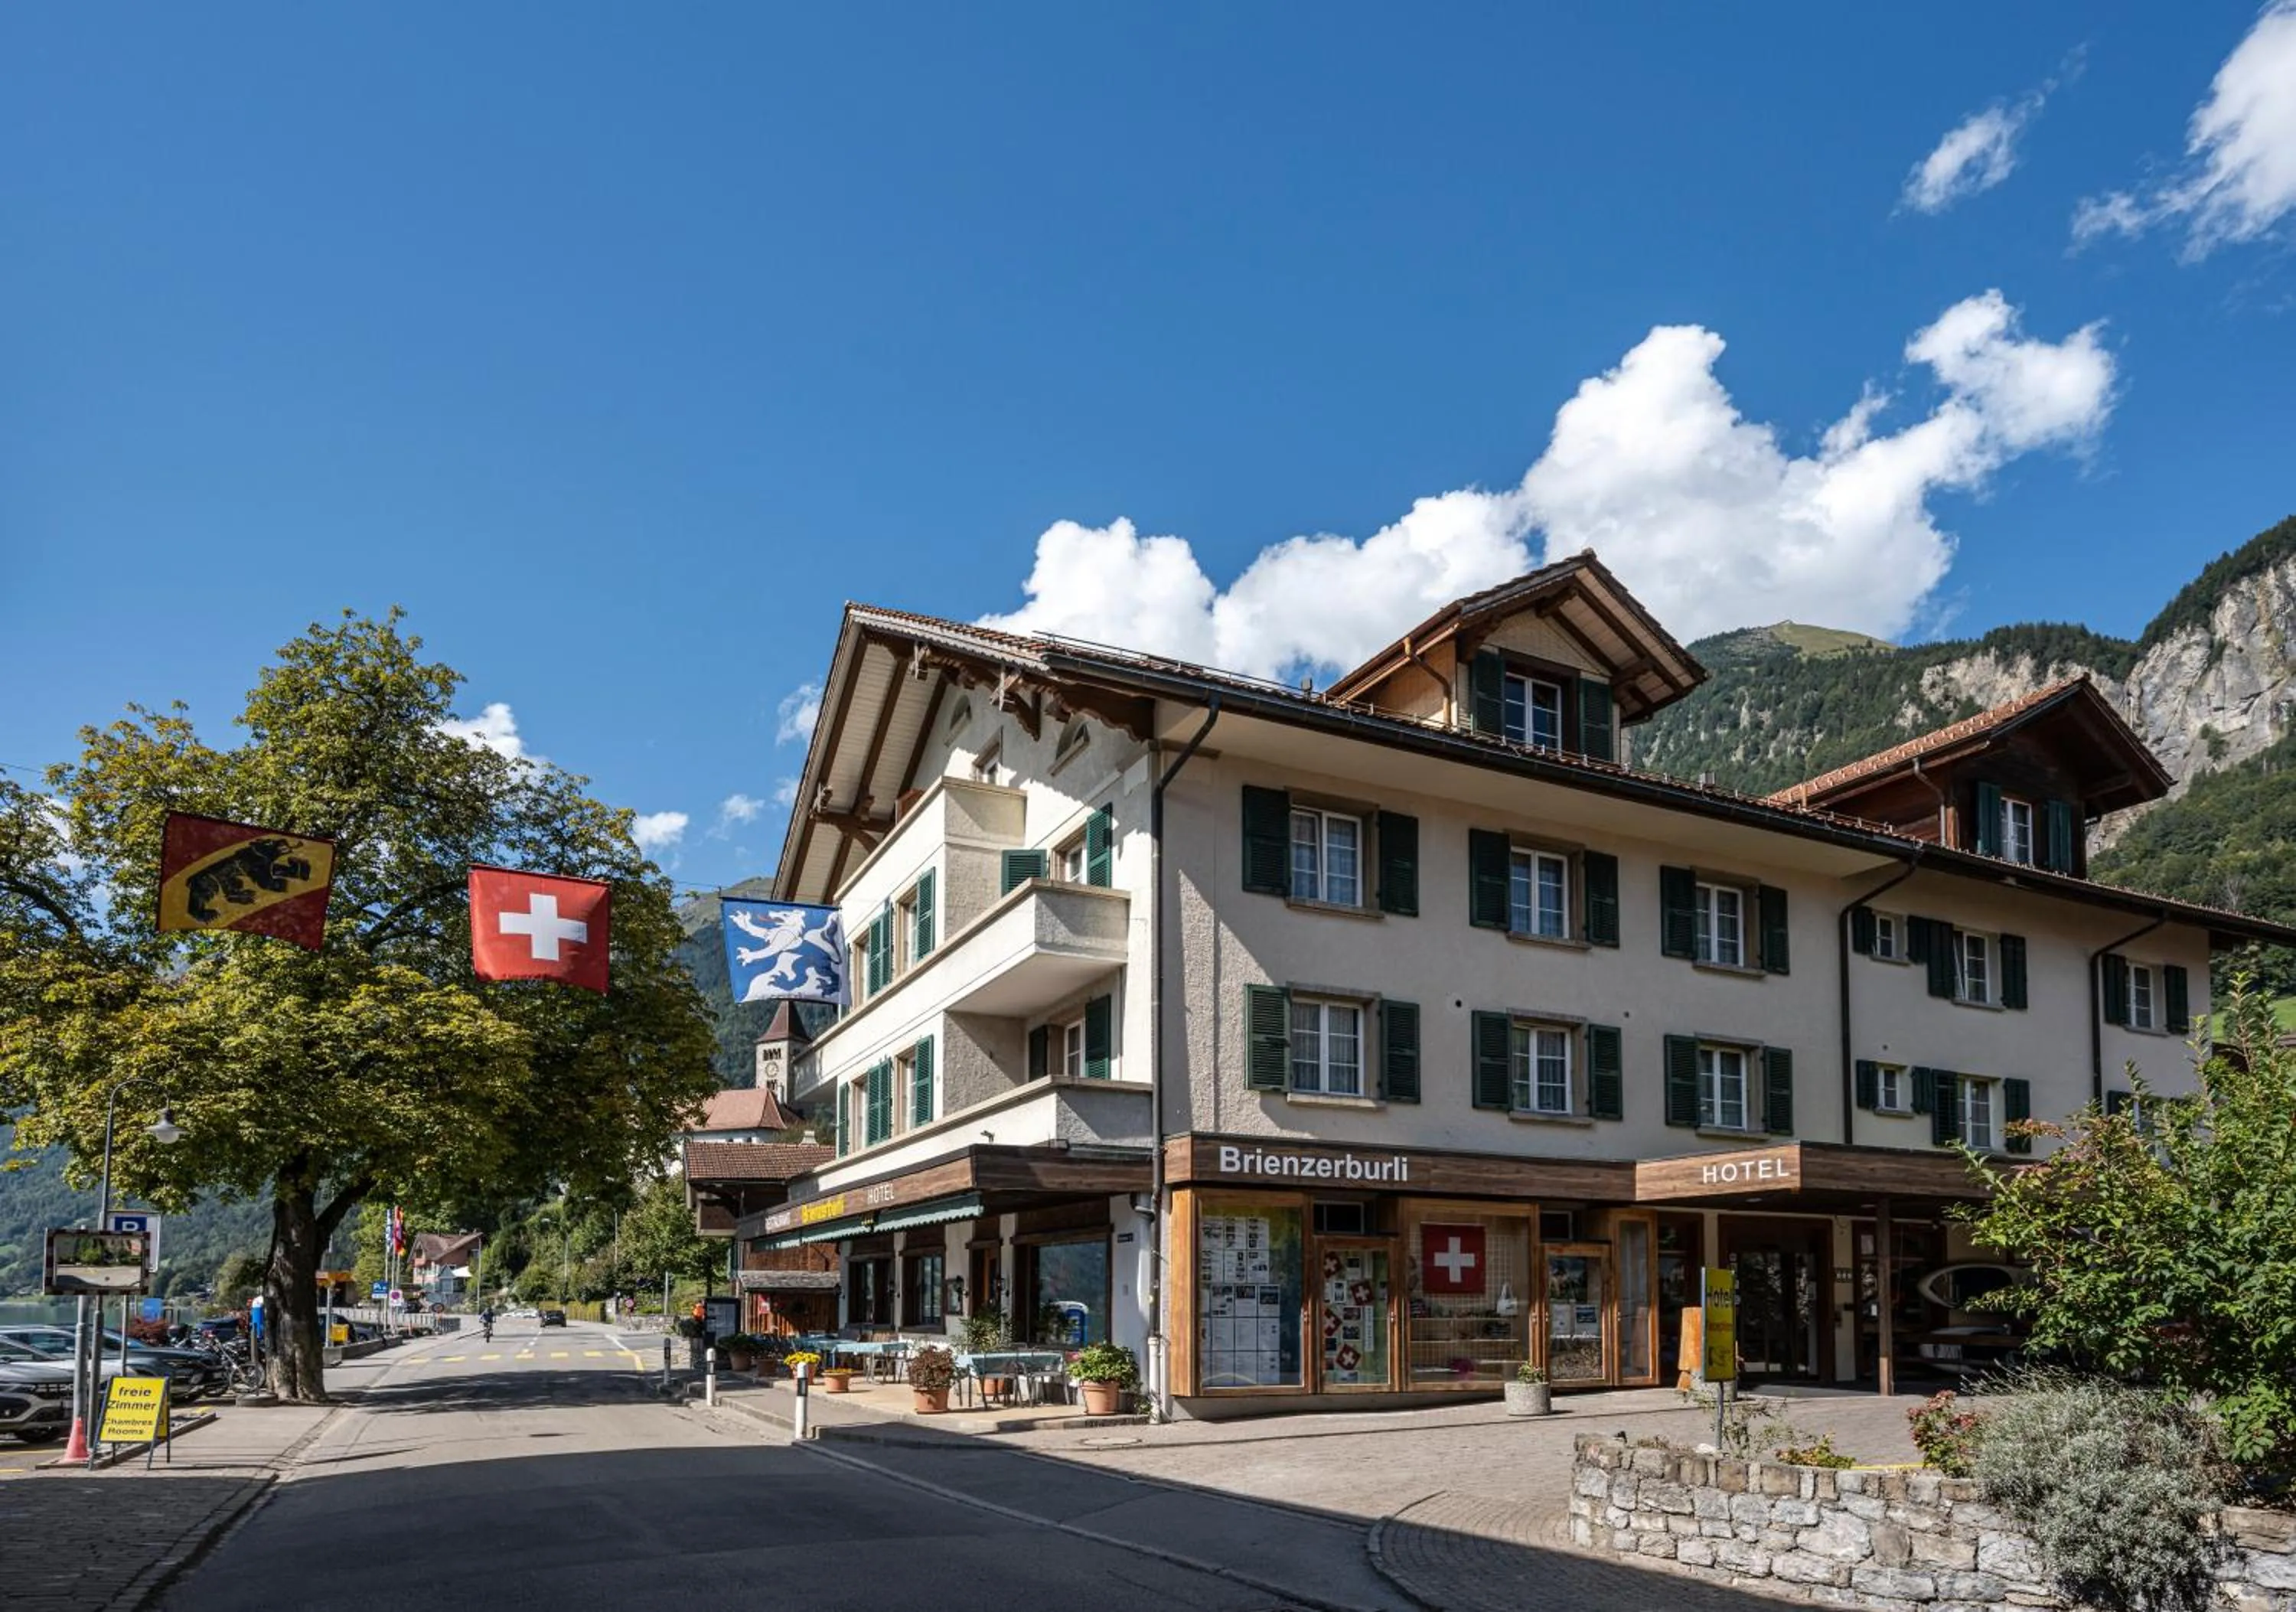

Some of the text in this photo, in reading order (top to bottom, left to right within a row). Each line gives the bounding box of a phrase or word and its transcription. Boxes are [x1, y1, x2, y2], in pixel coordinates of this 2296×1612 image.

[1220, 1146, 1407, 1182] Brienzerburli
[1703, 1157, 1790, 1183] HOTEL
[867, 1183, 895, 1204] HOTEL
[119, 1386, 152, 1396] freie
[107, 1400, 156, 1410] Zimmer
